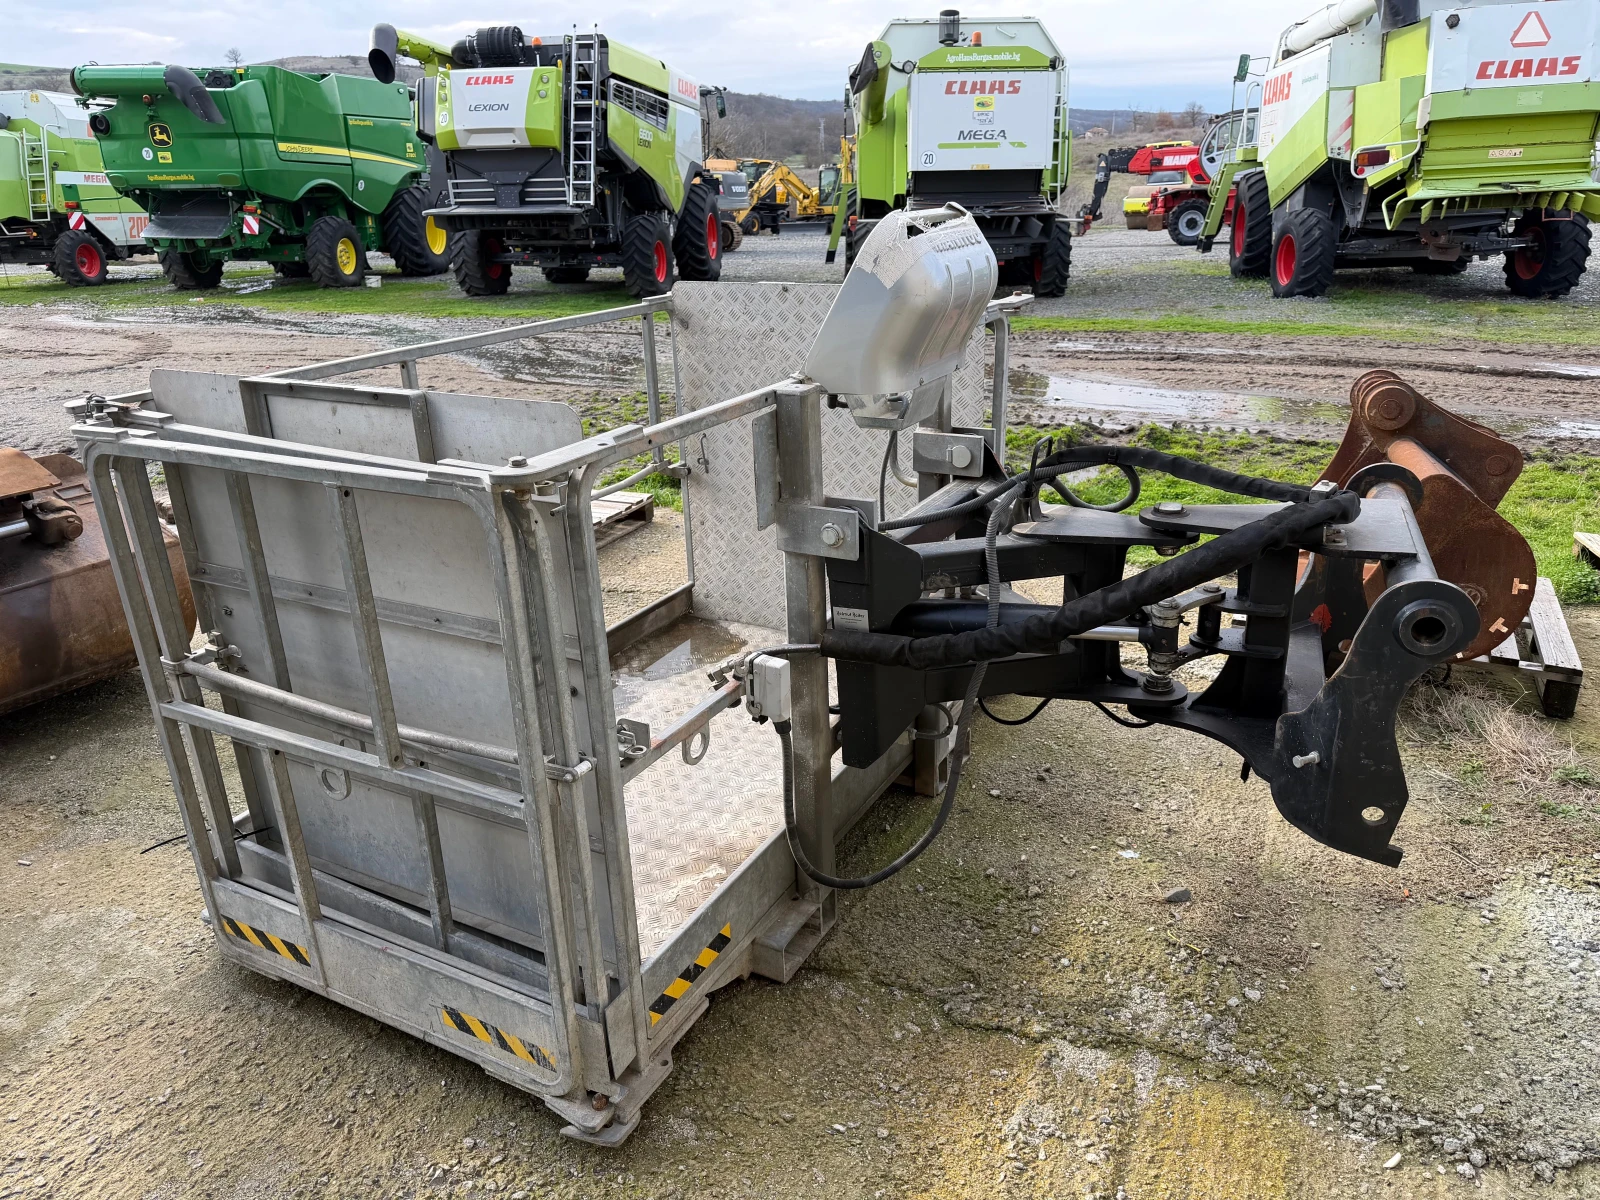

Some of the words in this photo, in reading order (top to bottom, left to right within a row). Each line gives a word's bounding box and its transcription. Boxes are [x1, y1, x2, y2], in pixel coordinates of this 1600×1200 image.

[1476, 55, 1582, 80] CLAAS
[465, 75, 515, 86] CLAAS
[678, 78, 697, 100] CLAAS
[944, 80, 1022, 95] CLAAS
[1263, 71, 1293, 106] CLAAS
[468, 103, 510, 112] LEXION
[440, 113, 448, 124] 20
[957, 129, 1008, 141] MEGA
[285, 145, 298, 153] JOHN
[637, 138, 651, 149] LEXION
[923, 153, 934, 165] 20
[84, 174, 108, 184] MEGA
